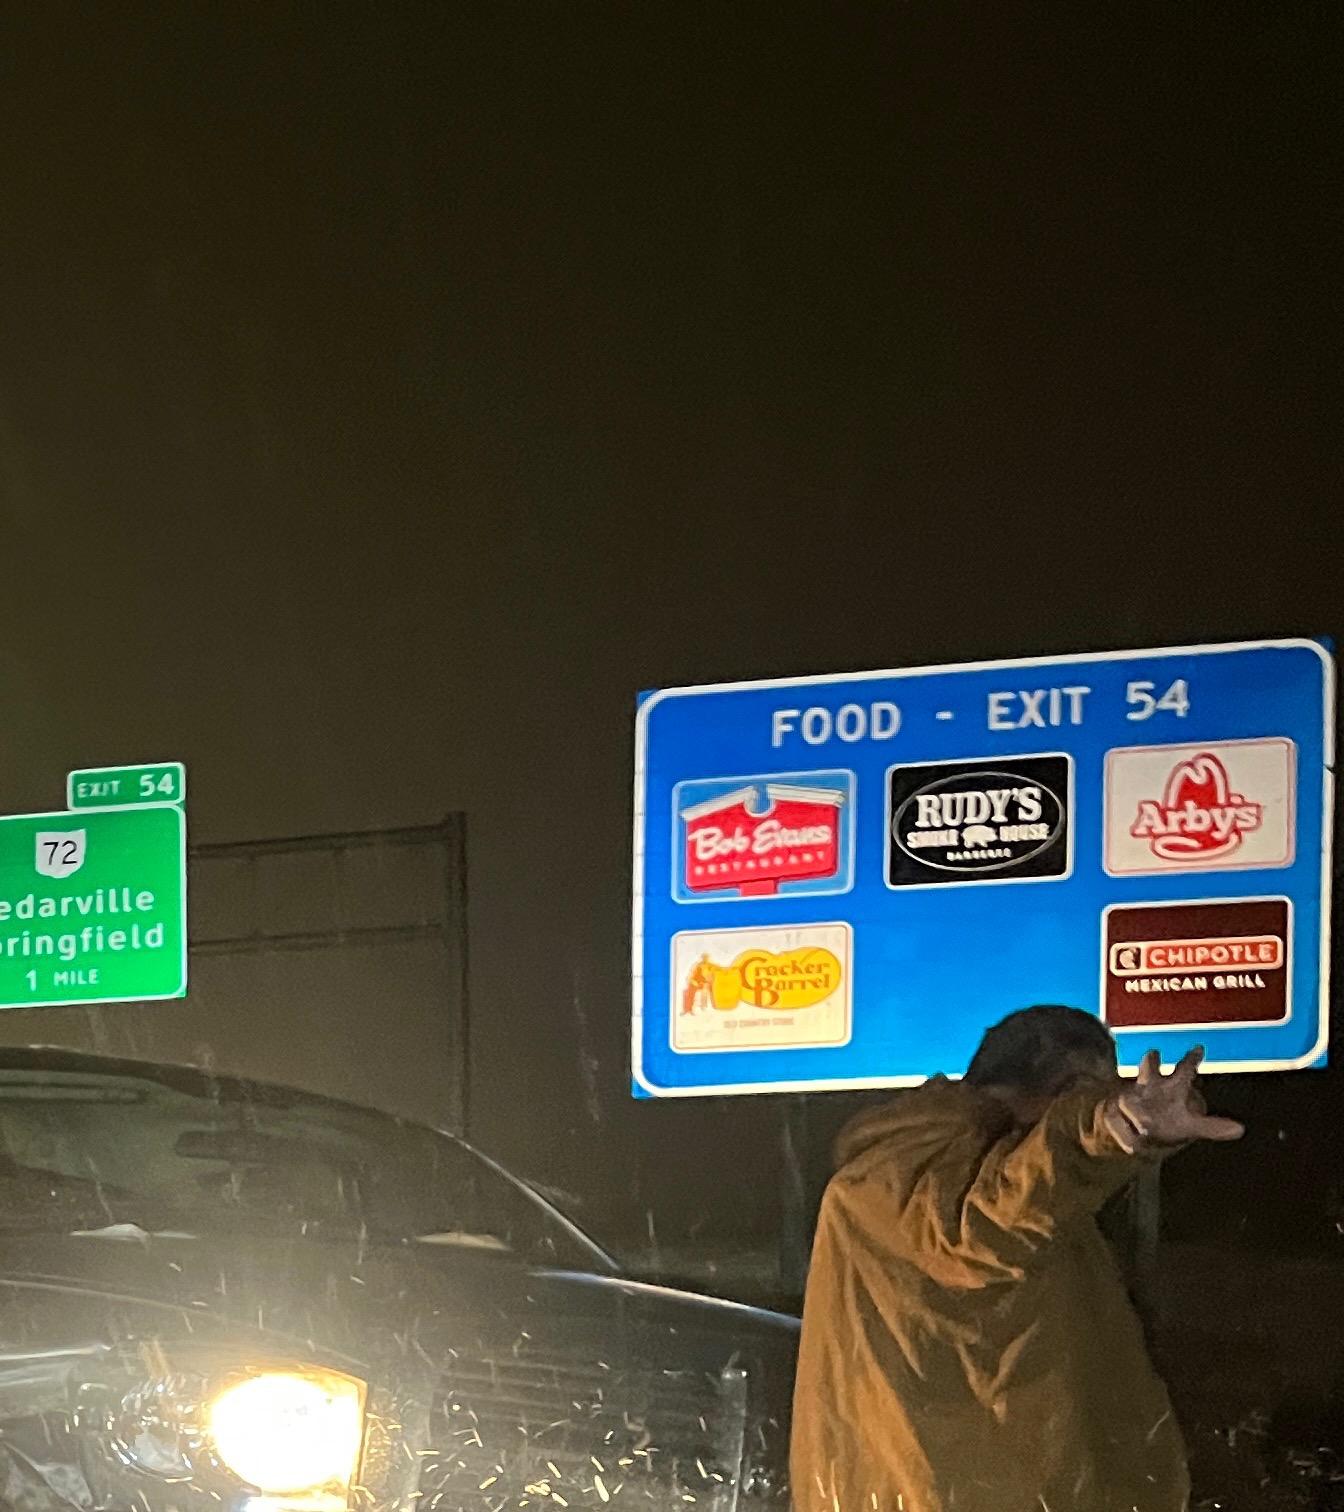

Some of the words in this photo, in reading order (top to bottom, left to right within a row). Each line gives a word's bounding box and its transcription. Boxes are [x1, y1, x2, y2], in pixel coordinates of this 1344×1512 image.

[772, 702, 900, 748] FOOD
[987, 687, 1091, 730] EXIT
[1126, 679, 1190, 721] 54
[77, 780, 120, 798] EXIT
[139, 773, 174, 797] 54
[914, 787, 1043, 828] RUDY'S
[1134, 793, 1260, 840] Arby's
[43, 840, 78, 865] 72
[688, 826, 750, 860] Bob
[752, 819, 833, 854] Evans
[1149, 943, 1275, 967] CHIPOTLE
[25, 969, 37, 991] 1
[53, 968, 99, 986] MILE
[739, 956, 831, 991] Cracker
[1125, 976, 1208, 993] MEXICAN
[1213, 974, 1266, 989] GRILL
[754, 974, 831, 1008] Barrel
